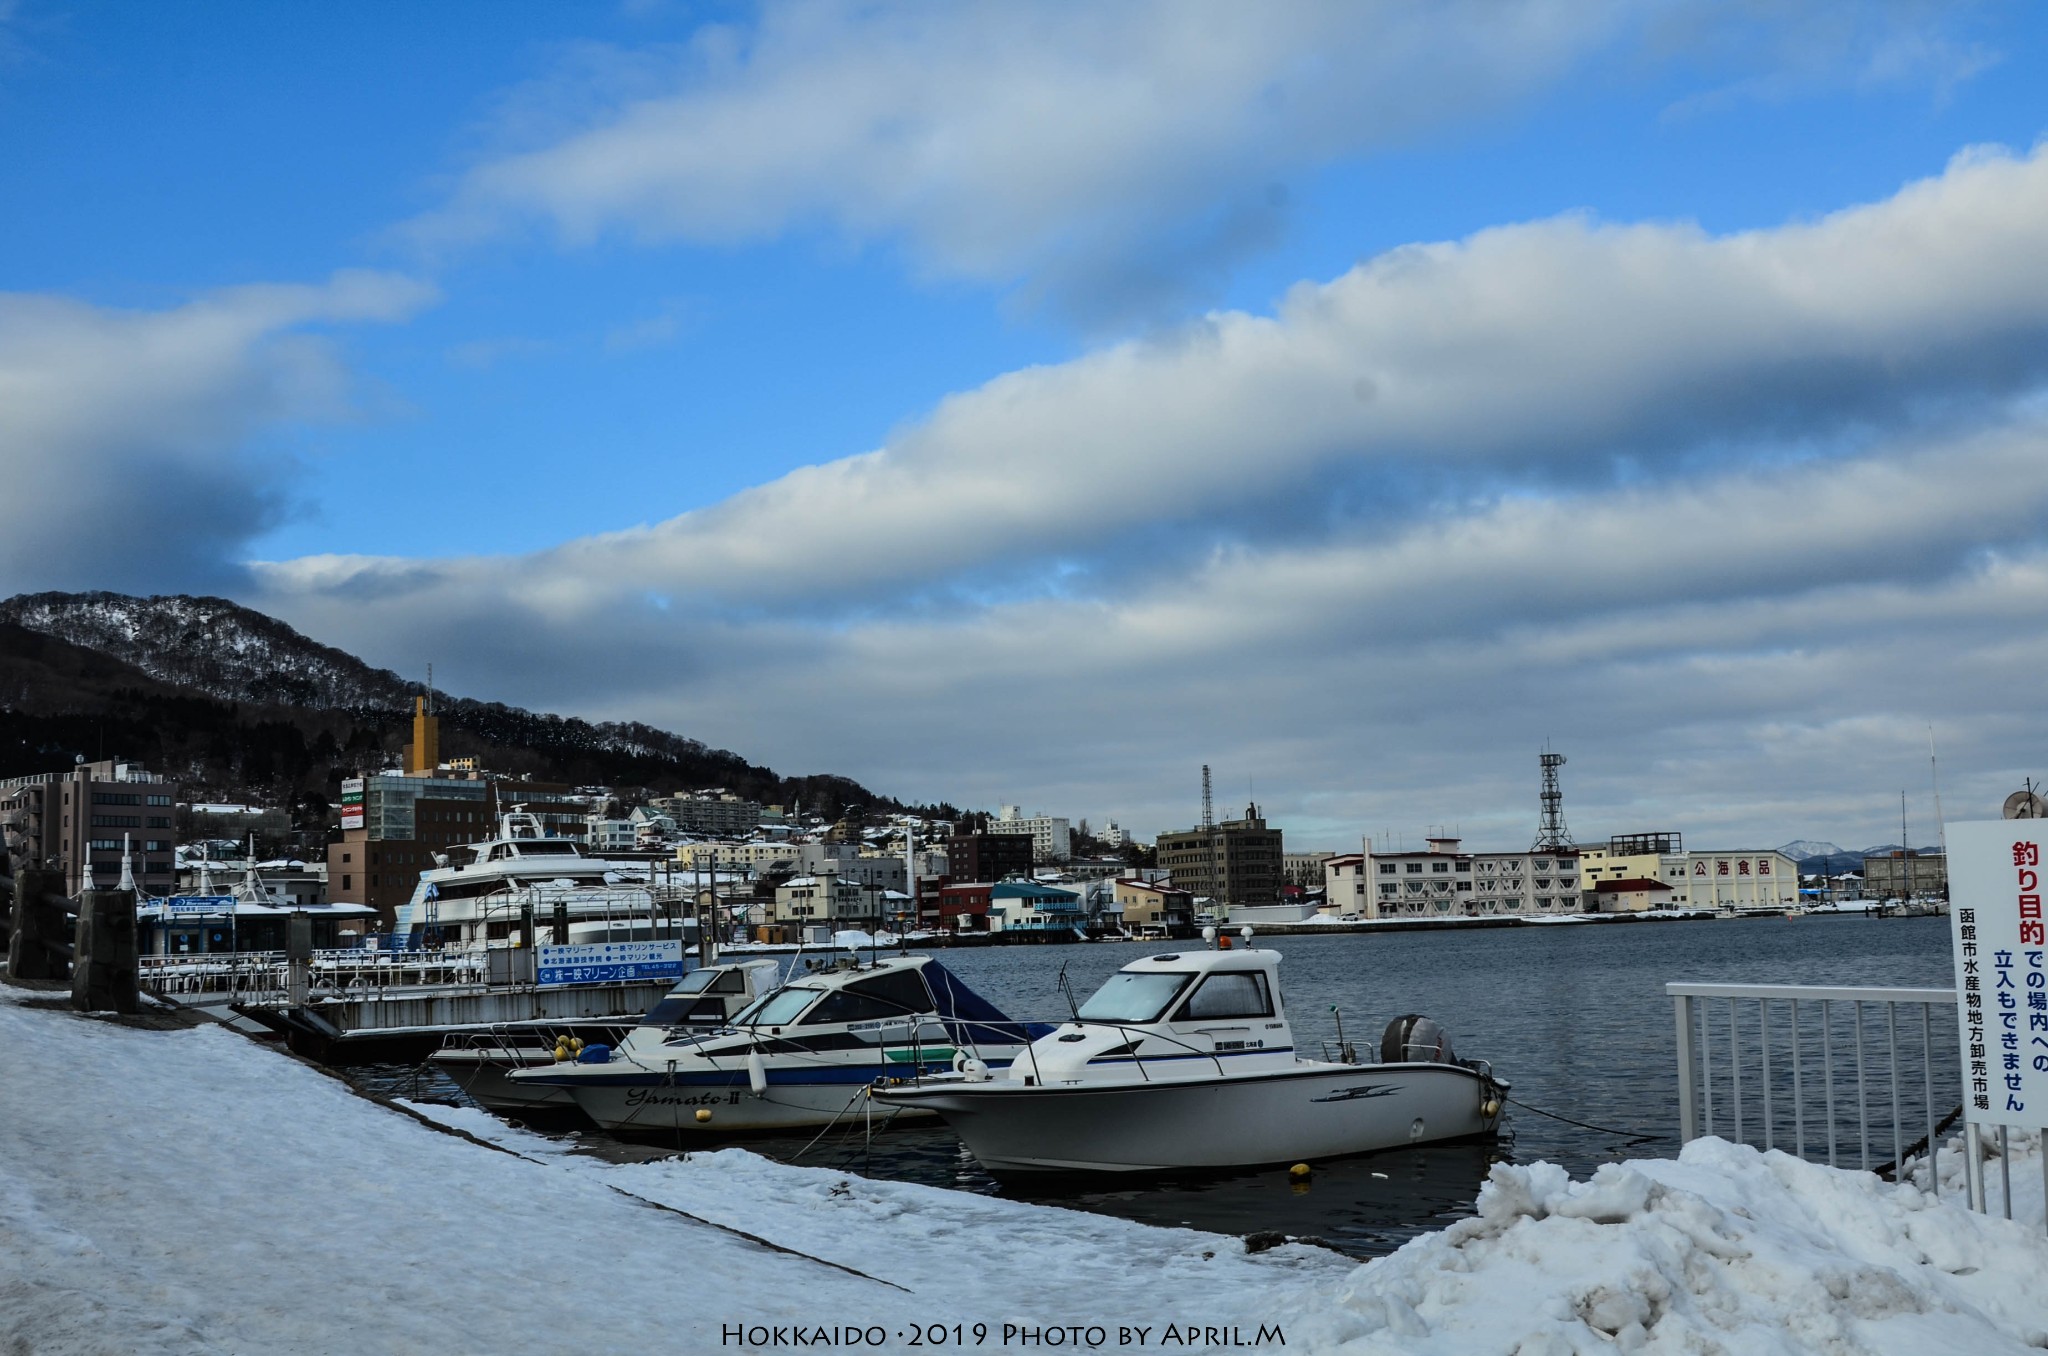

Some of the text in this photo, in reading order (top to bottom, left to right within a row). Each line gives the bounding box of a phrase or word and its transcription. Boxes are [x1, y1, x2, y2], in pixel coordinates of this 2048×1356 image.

[1695, 860, 1770, 876] 公海食品
[1959, 908, 1990, 1111] 函館市水産物地方卸売市場
[1994, 950, 2025, 1112] 立入もできません
